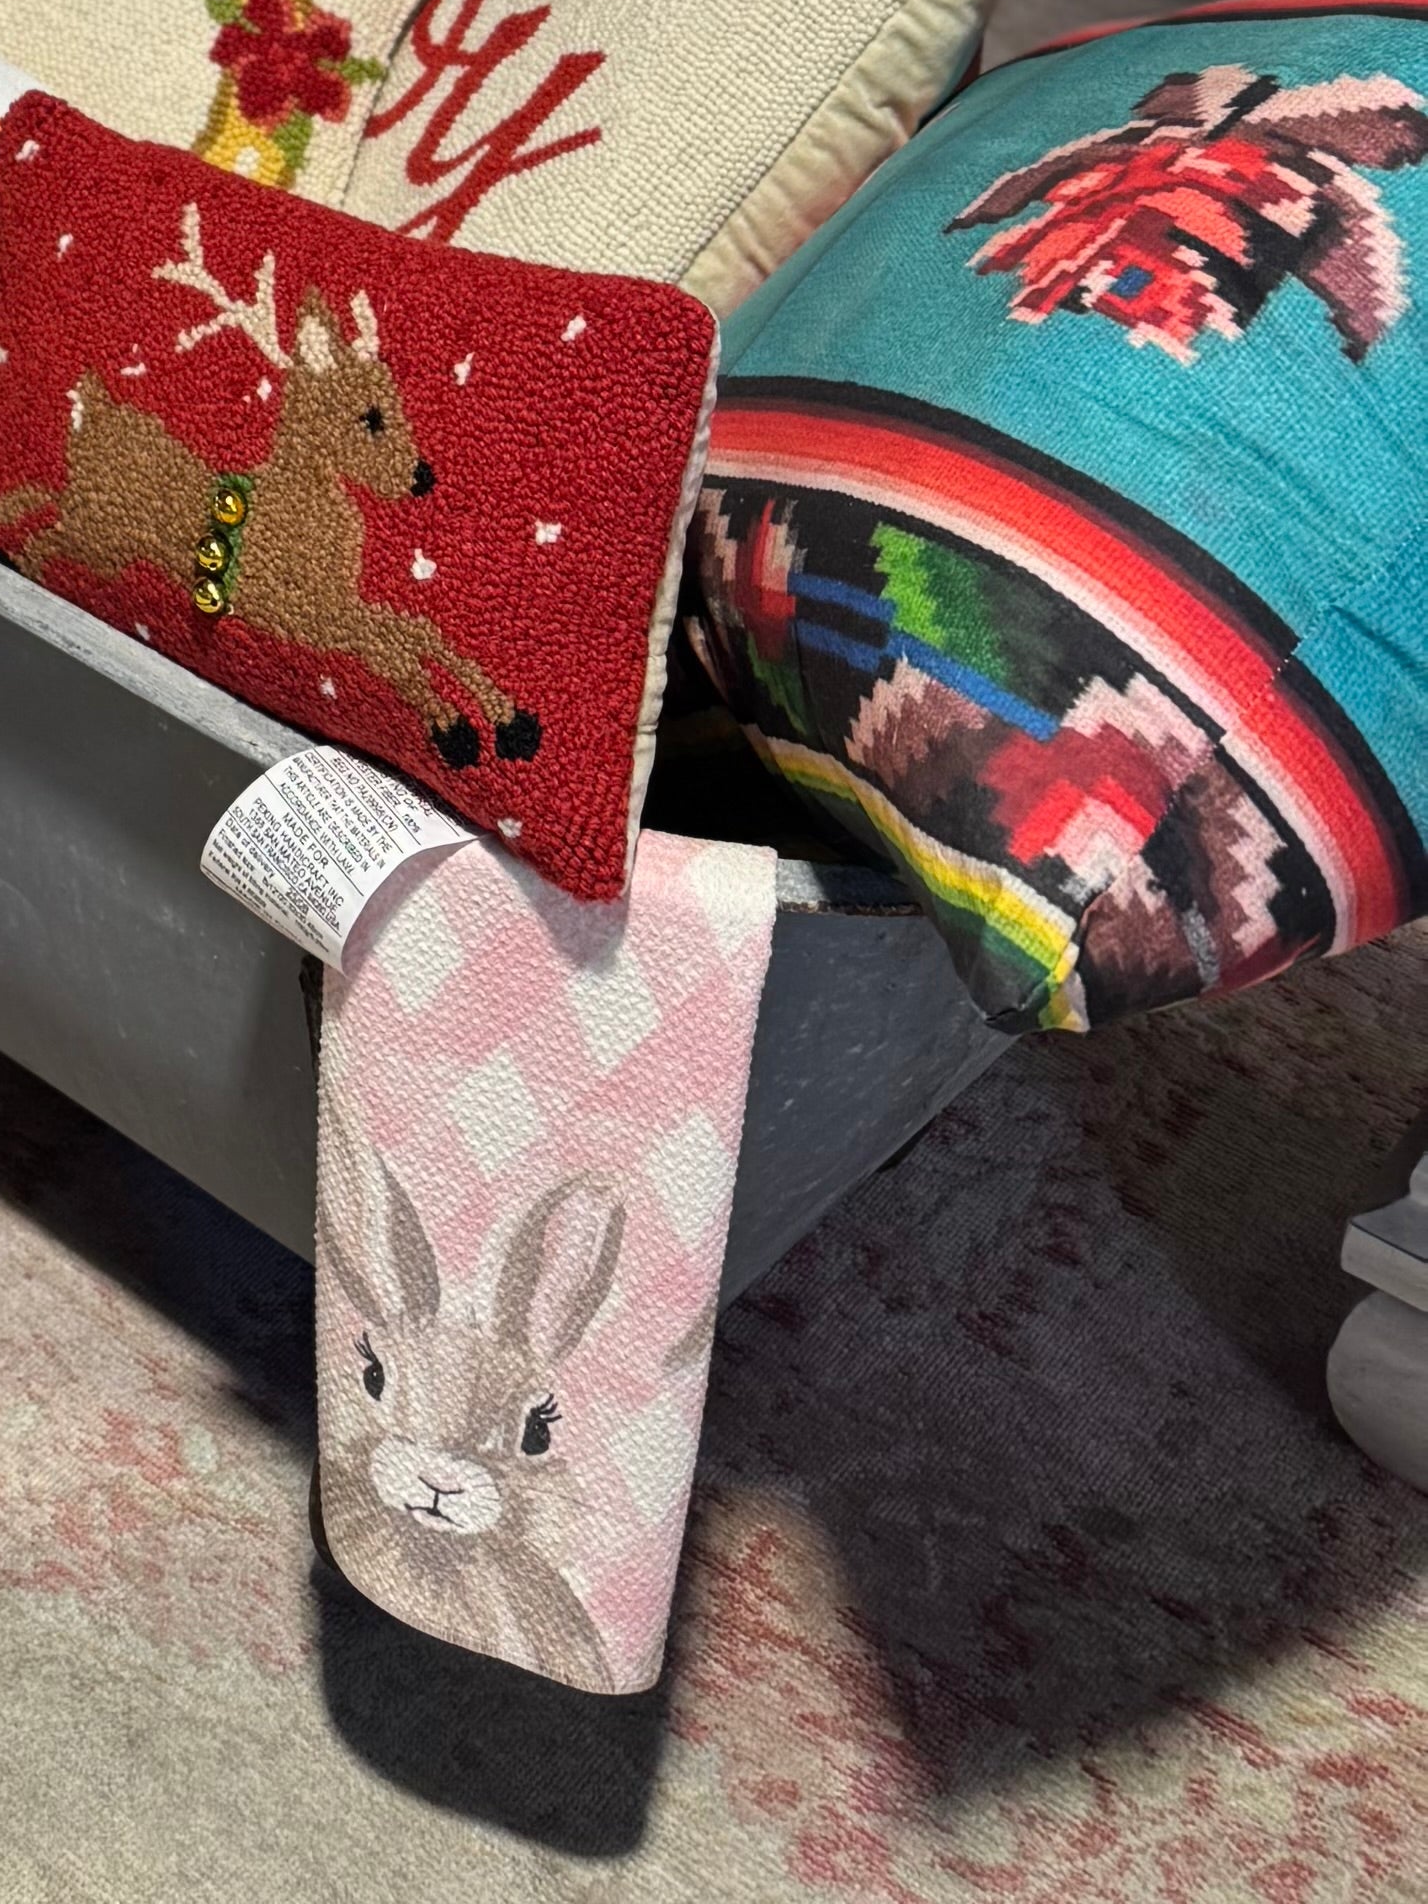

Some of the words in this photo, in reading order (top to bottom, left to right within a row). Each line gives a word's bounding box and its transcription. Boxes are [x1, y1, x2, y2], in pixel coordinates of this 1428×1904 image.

[253, 796, 282, 833] PEKING
[280, 830, 330, 888] HANDICRAFT
[282, 812, 310, 846] MADE
[307, 842, 329, 870] FOR
[304, 752, 347, 800] CERTIFICATION
[350, 806, 372, 828] MADE
[376, 835, 393, 854] THE
[232, 806, 254, 830] SOUTH
[250, 828, 265, 846] SAN
[264, 843, 299, 885] FRANCISCO
[248, 847, 275, 879] delivery
[263, 826, 280, 849] SAN
[278, 845, 306, 879] MATEO
[304, 876, 338, 914] AVENUE
[319, 831, 340, 856] WITH
